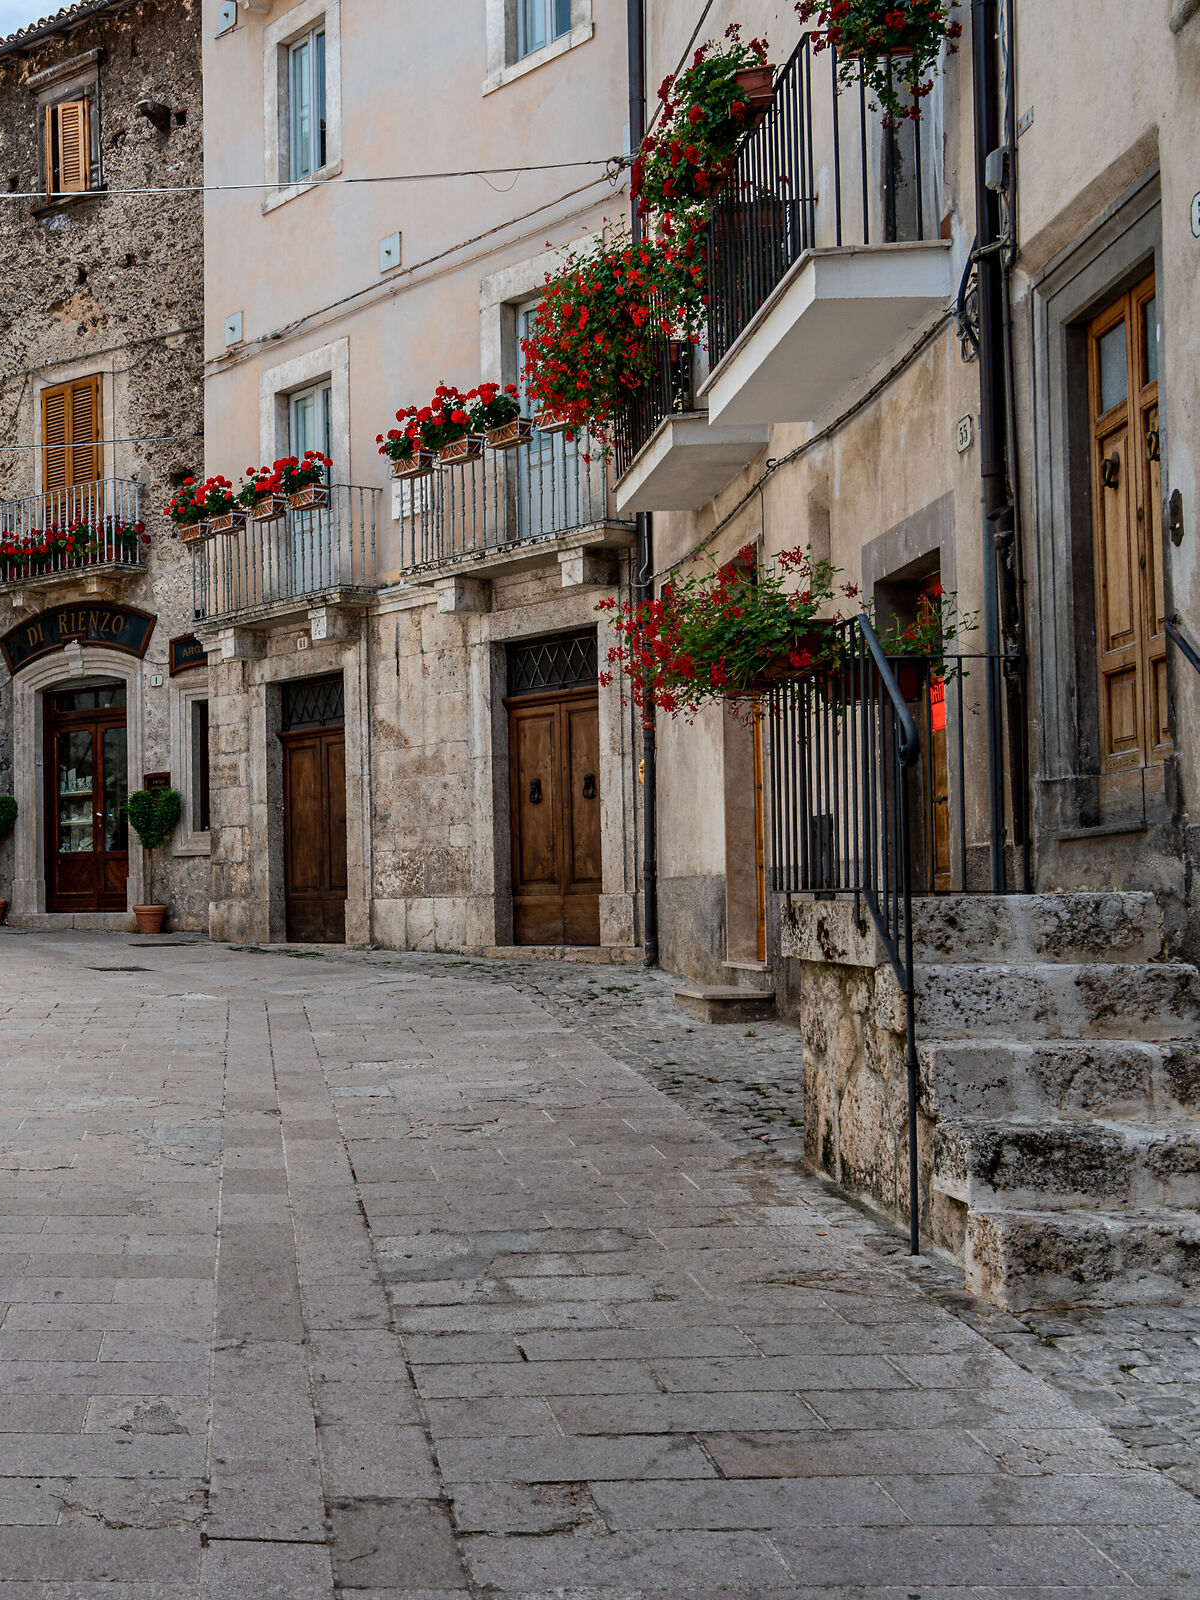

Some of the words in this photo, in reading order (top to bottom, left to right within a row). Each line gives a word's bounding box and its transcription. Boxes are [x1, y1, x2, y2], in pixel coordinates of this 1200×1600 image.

[27, 623, 44, 647] DI
[58, 610, 125, 634] RIENZO
[182, 644, 203, 657] ARG
